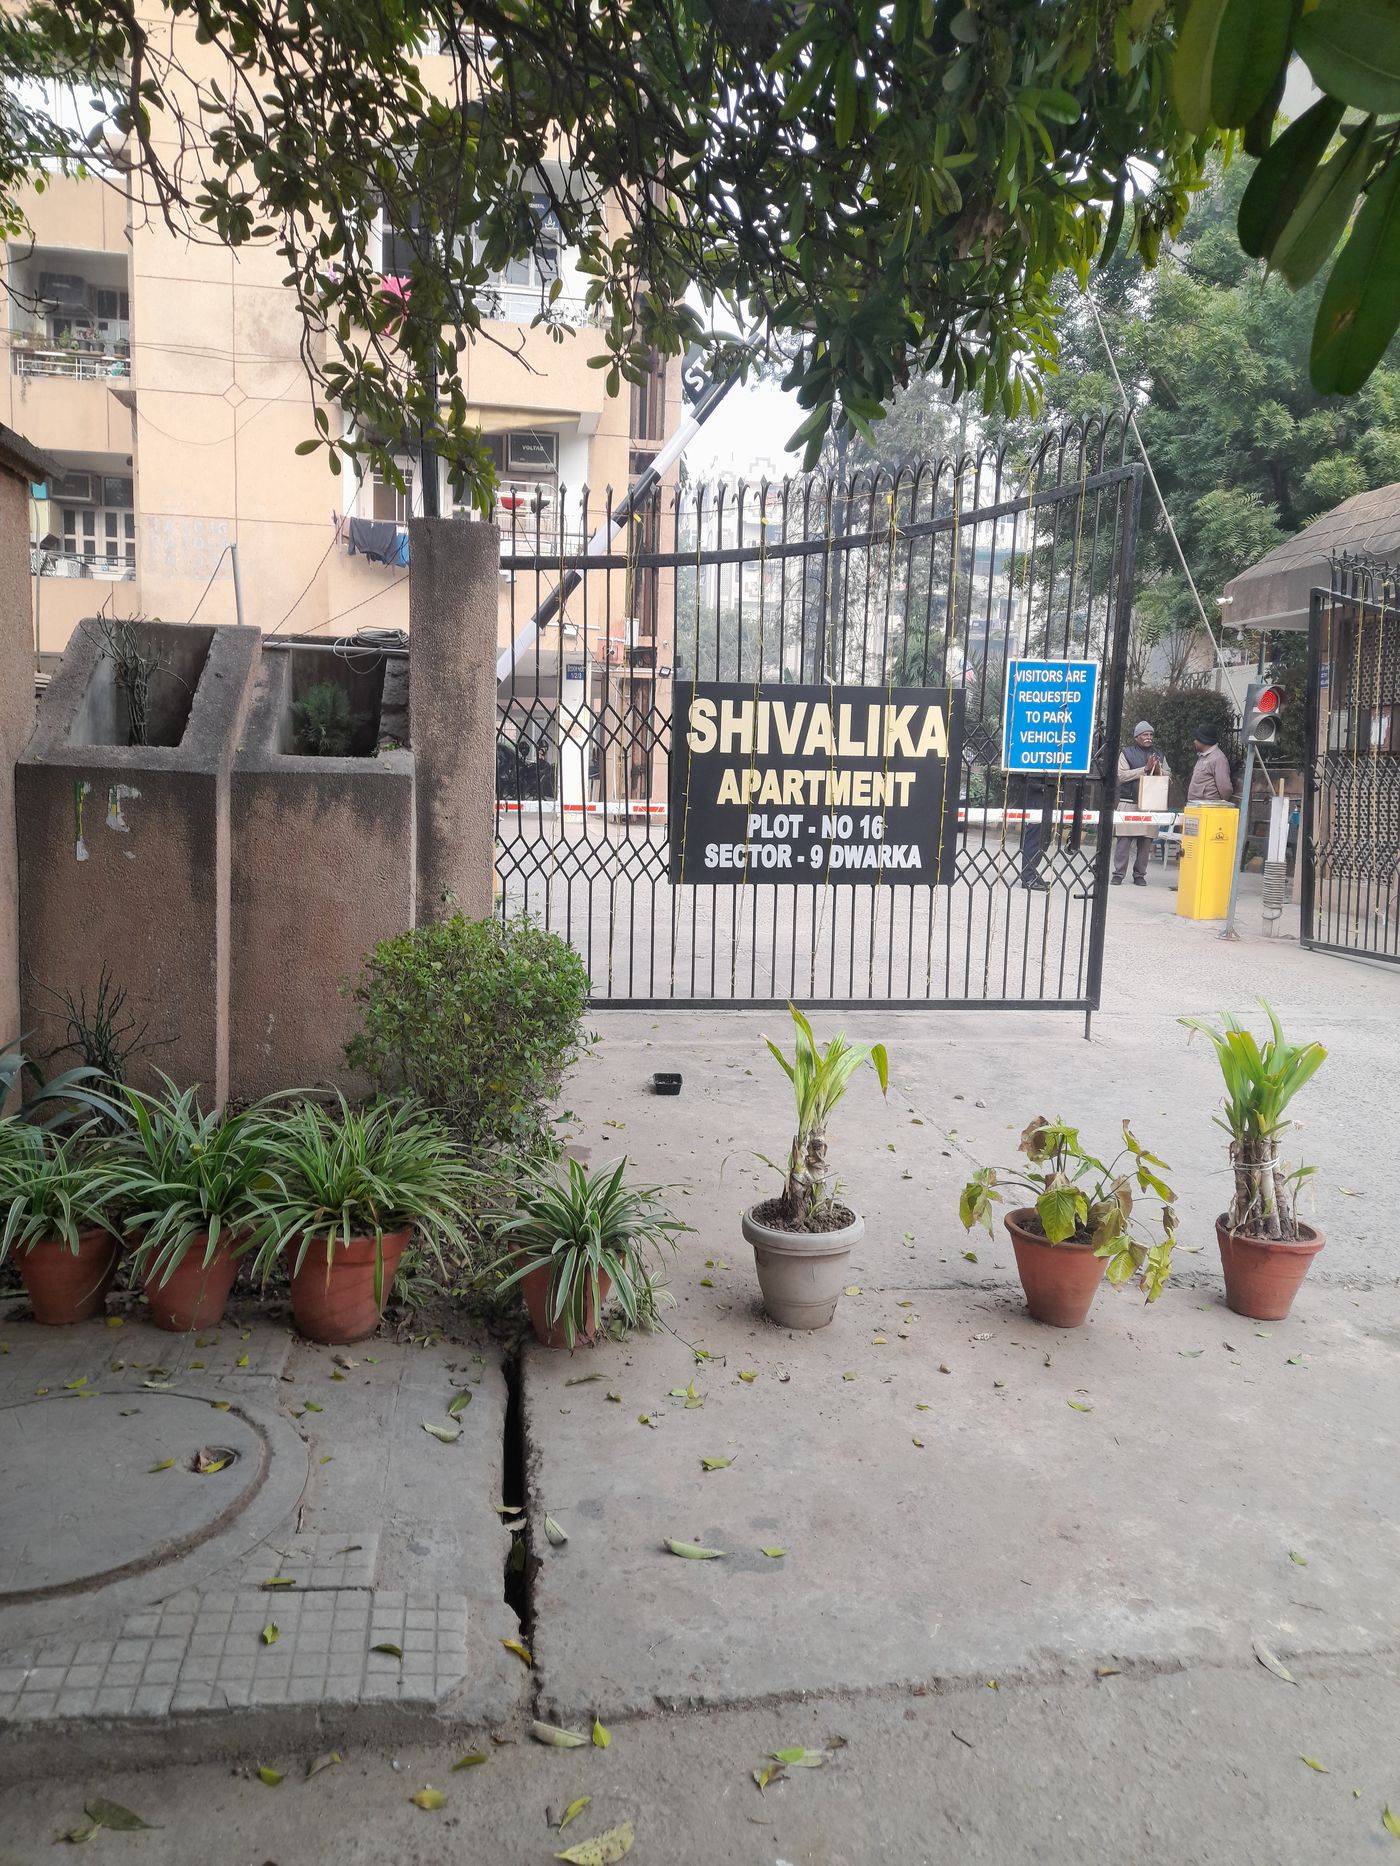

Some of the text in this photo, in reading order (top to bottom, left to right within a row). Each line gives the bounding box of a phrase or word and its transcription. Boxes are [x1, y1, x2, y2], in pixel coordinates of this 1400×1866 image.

[1016, 670, 1087, 683] VISITORS ARE
[1018, 691, 1081, 703] REQUESTED
[1026, 711, 1073, 724] TO PARK
[686, 698, 949, 758] SHIVALIKA
[1020, 731, 1076, 744] VEHICLES
[1021, 752, 1073, 764] OUTSIDE
[717, 769, 916, 807] APARTMENT
[748, 813, 803, 839] PLOT
[821, 814, 853, 839] NO
[860, 815, 884, 839] 16
[704, 843, 792, 869] SECTOR
[810, 845, 823, 869] 9
[829, 844, 922, 869] DWARKA
